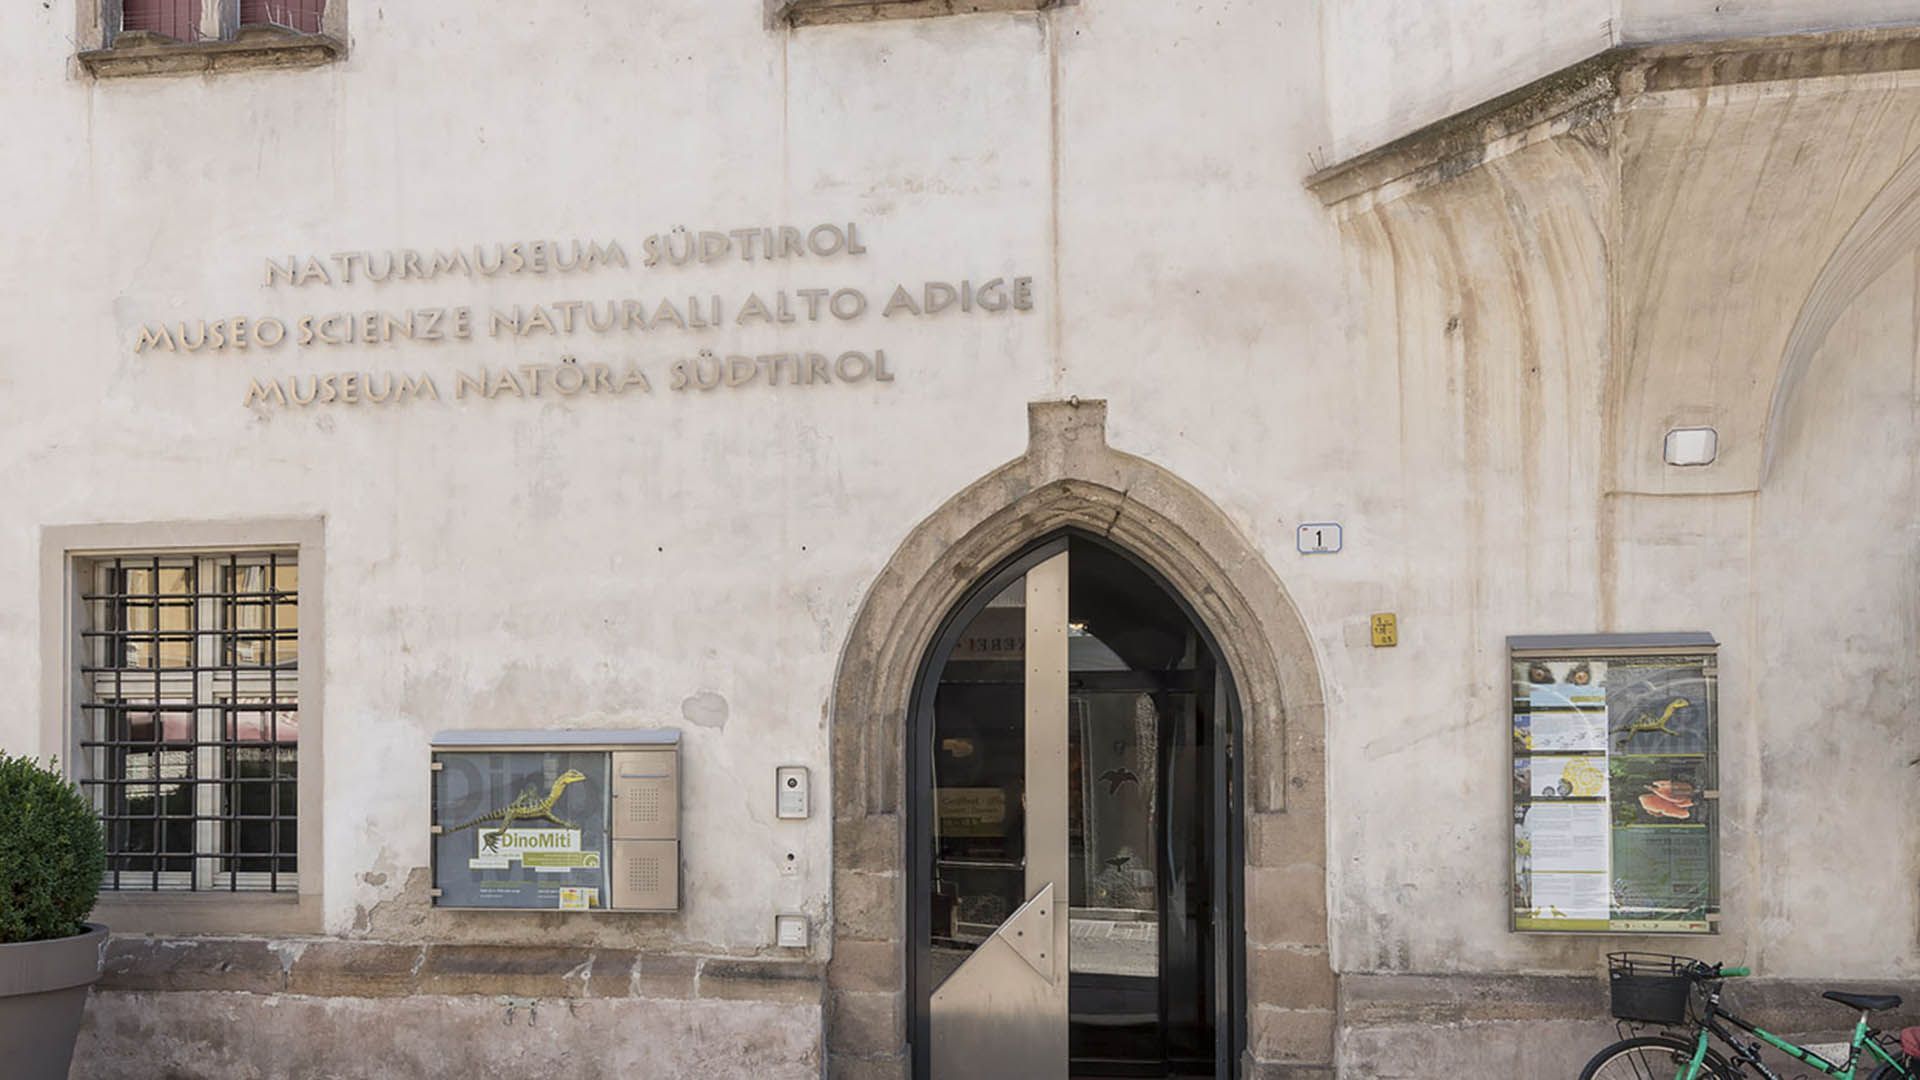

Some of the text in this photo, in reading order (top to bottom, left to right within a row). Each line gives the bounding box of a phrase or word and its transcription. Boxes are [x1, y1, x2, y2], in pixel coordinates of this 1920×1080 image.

[264, 222, 867, 288] NATURMUSEUM SÜDTIROL
[134, 276, 1034, 354] MUSEO SCIENZE NATURALI ALTO ADIGE
[243, 349, 895, 408] MUSEUM NATÖRA SÜDTIROL
[1316, 530, 1322, 547] 1
[502, 832, 571, 849] DinoMiti
